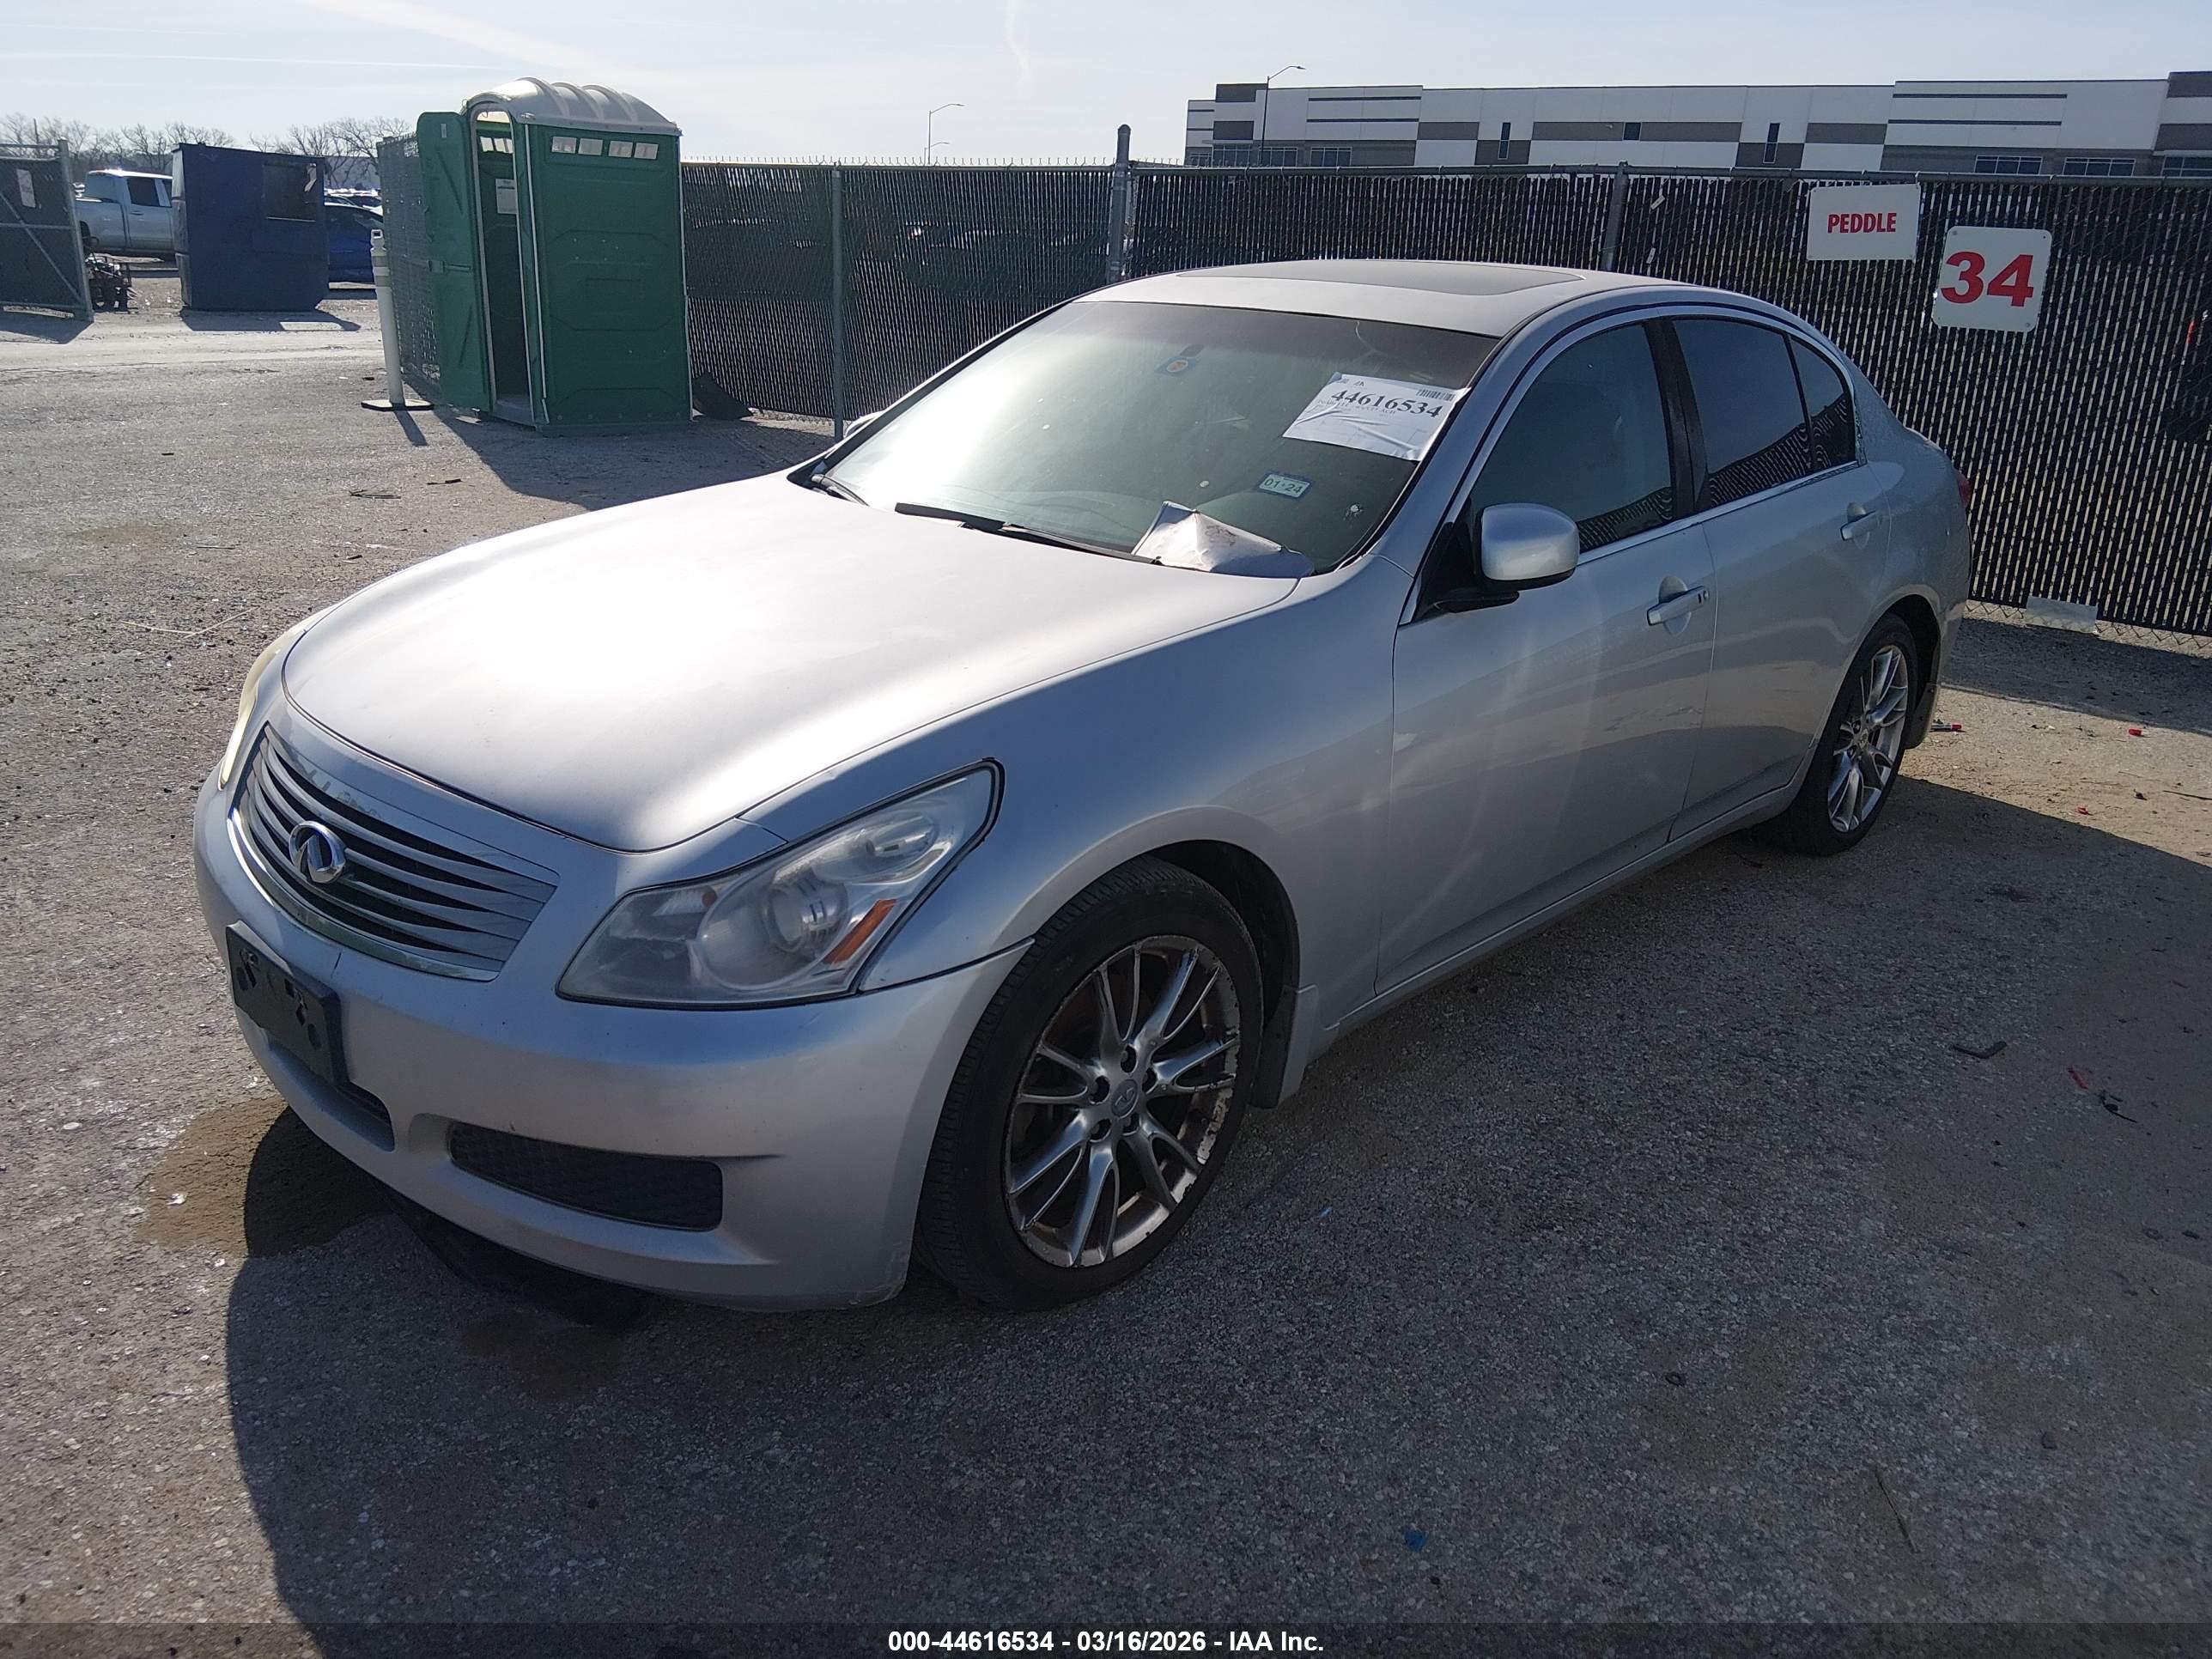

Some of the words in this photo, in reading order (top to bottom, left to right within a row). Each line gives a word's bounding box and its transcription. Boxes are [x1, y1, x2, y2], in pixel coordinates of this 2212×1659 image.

[1827, 212, 1897, 234] PEDDLE
[1941, 251, 2034, 307] 34
[1331, 389, 1443, 417] 44616534
